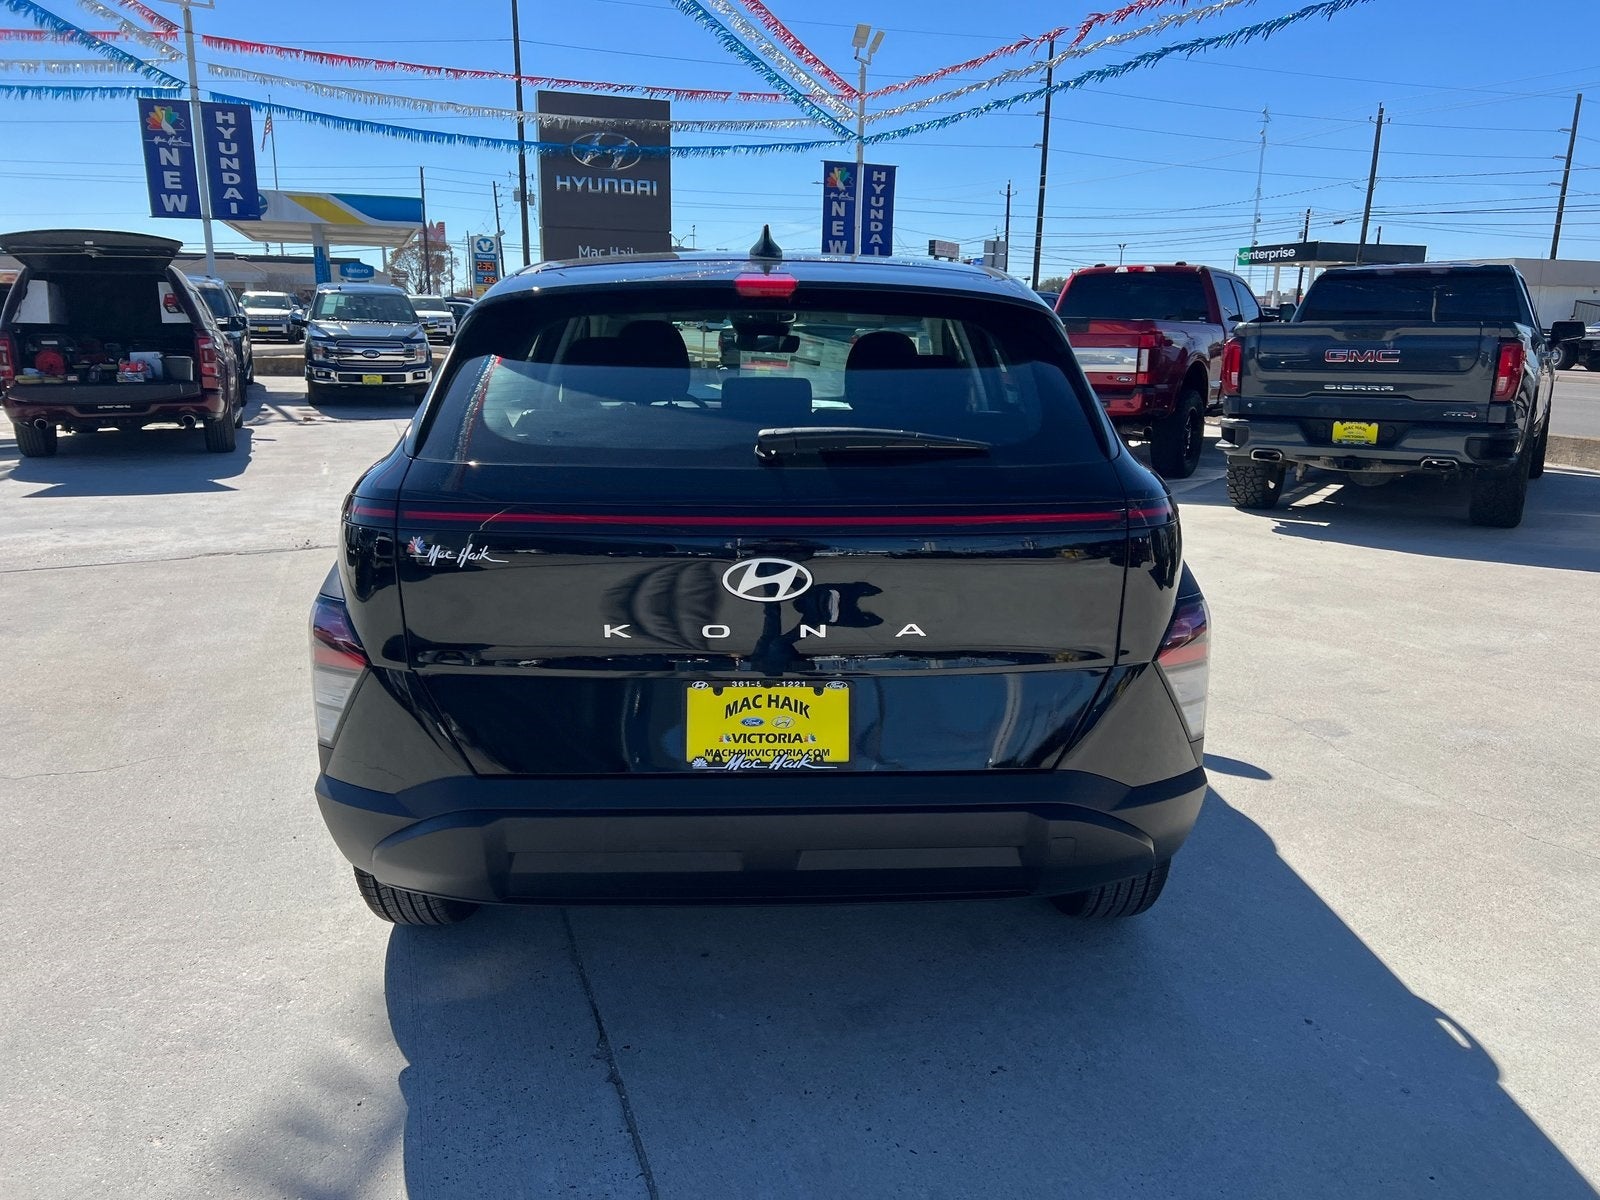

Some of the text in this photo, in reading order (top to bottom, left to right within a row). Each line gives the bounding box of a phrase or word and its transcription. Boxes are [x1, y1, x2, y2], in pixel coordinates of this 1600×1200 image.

[215, 111, 243, 214] HYUNDAI
[159, 147, 188, 212] NEW
[555, 175, 657, 196] HYUNDAI
[869, 171, 886, 256] HYUNDAI
[828, 201, 847, 254] NEW
[578, 245, 605, 258] Mac
[1240, 247, 1296, 261] enterprise
[1324, 350, 1401, 363] GMC
[420, 543, 509, 568] Mac Haik
[604, 623, 926, 638] KONA
[724, 694, 810, 719] MAC HAIK
[732, 733, 804, 744] VICTORIA
[704, 748, 830, 757] MACHAIKVICTORIA.COM
[719, 753, 829, 770] Mac Haik
